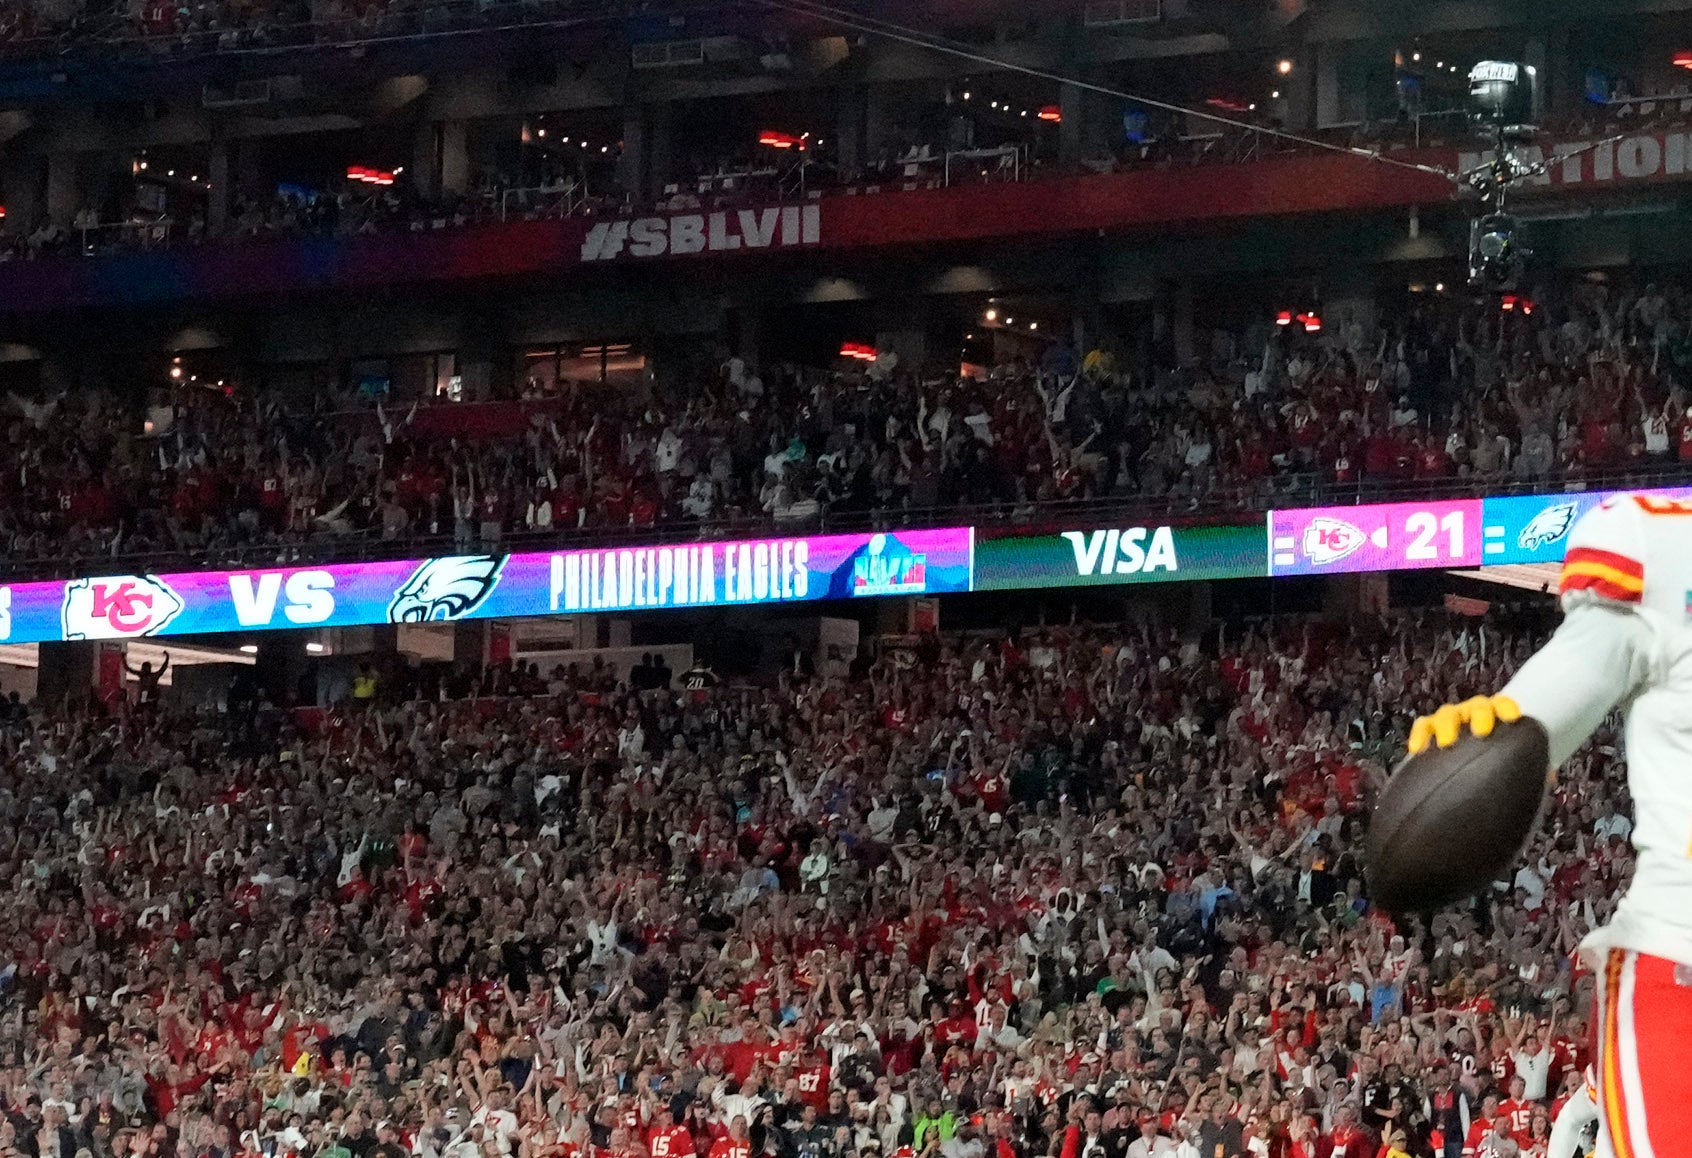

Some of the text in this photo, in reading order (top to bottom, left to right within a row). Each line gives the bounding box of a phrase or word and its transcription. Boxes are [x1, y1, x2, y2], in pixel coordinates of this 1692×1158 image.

[580, 204, 820, 262] #SBLVII
[1061, 526, 1177, 575] VISA
[1405, 511, 1464, 560] 21
[229, 570, 335, 627] VS
[549, 541, 808, 610] PHILADELPHIA EAGLES
[799, 1074, 820, 1092] 87
[1511, 1110, 1530, 1131] 15
[652, 1136, 670, 1156] 15
